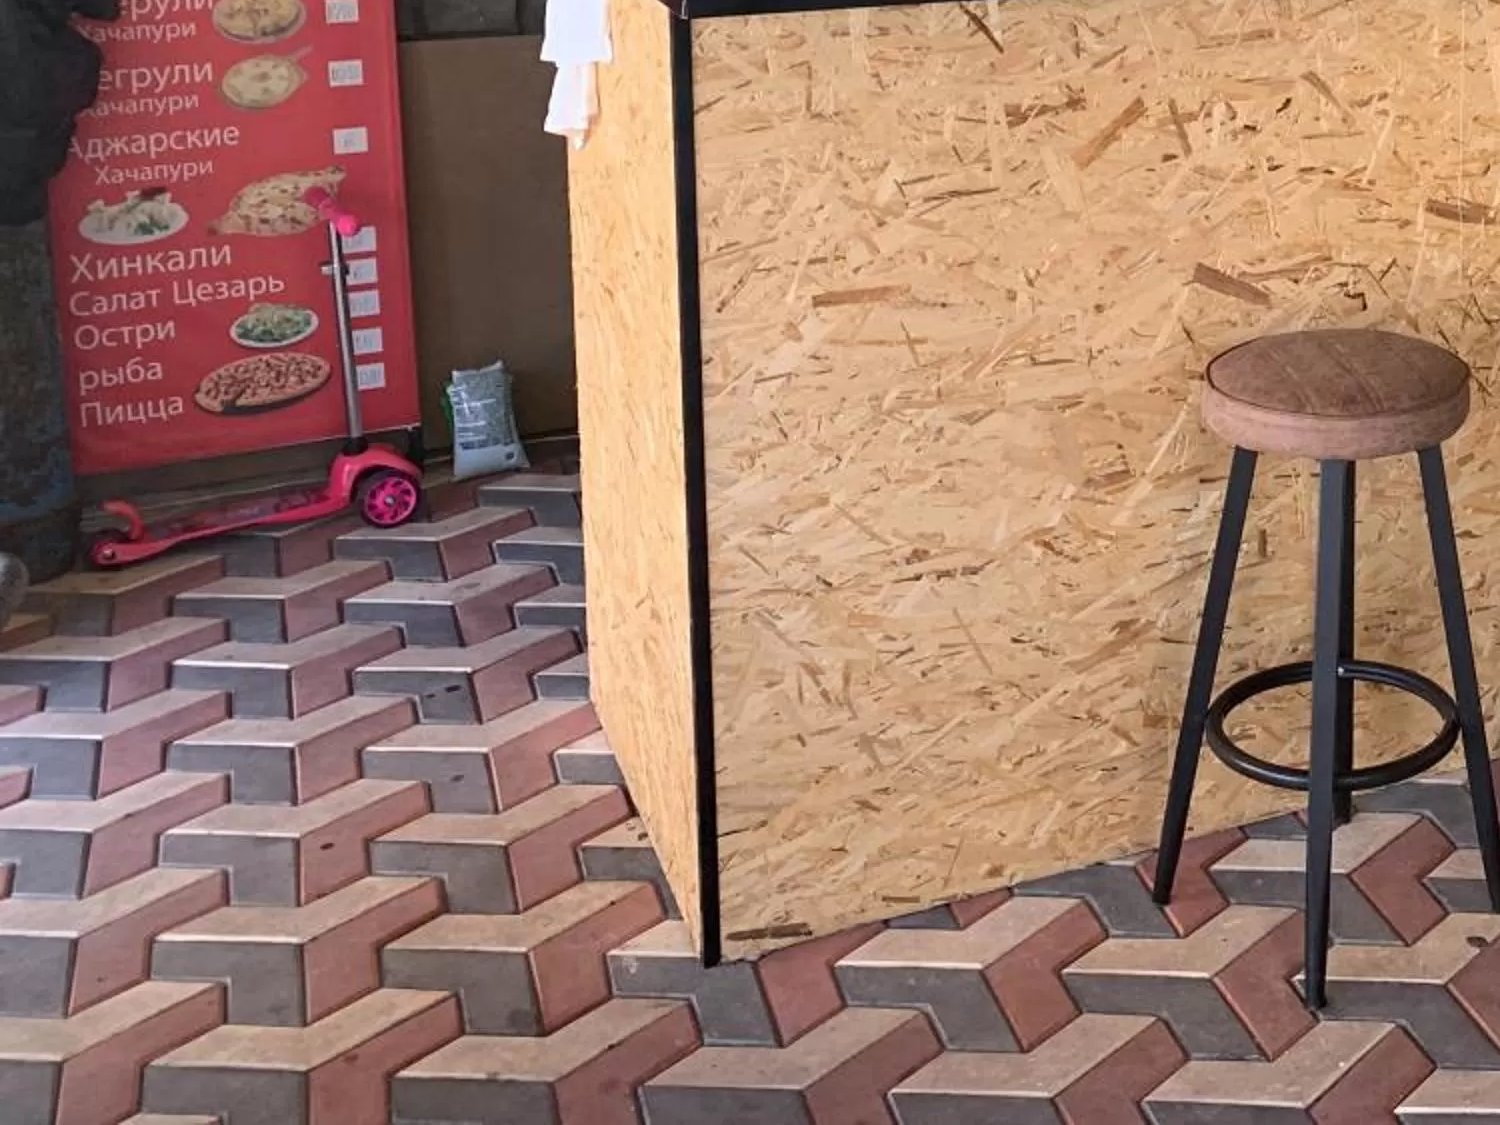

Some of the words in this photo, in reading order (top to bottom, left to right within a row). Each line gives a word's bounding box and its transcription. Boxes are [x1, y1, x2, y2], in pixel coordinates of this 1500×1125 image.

[98, 62, 213, 95] егрули
[68, 126, 240, 165] Аджарские
[94, 160, 214, 185] Хачапури
[70, 244, 232, 283] Хинкали
[69, 289, 161, 316] Салат
[172, 275, 285, 306] Цезарь
[74, 320, 176, 349] Остри
[79, 357, 163, 396] рыба
[80, 396, 184, 427] Пицца
